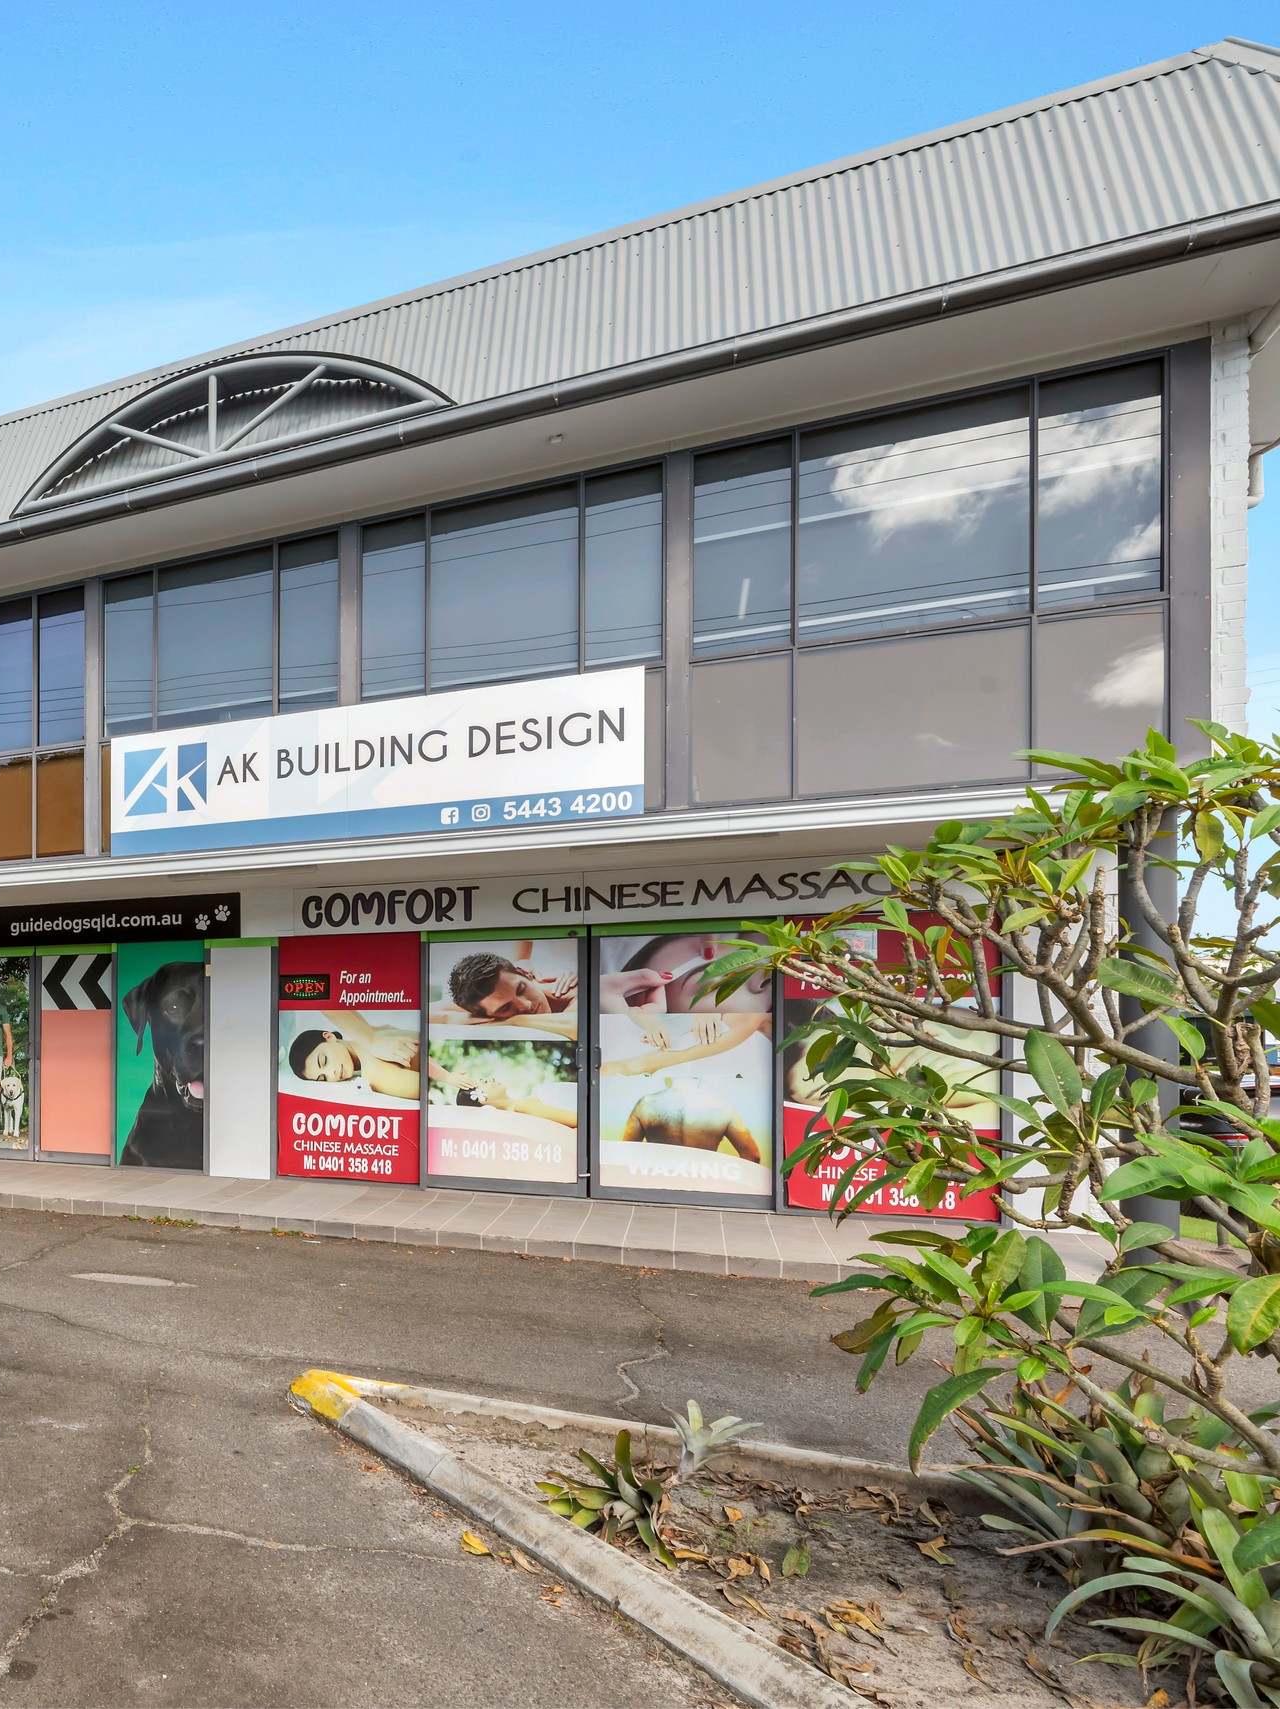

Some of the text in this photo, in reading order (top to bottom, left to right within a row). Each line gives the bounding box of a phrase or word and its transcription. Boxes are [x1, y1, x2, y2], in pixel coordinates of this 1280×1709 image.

[216, 707, 625, 786] AK BUILDING DESIGN
[503, 790, 633, 820] 5443 4200
[302, 870, 905, 929] COMFORT CHINESE MASSAG
[11, 913, 182, 936] guidedogsqld.com.au
[284, 982, 326, 993] OPEN
[340, 970, 372, 984] For an
[339, 989, 412, 1006] Appointment...
[292, 1112, 403, 1140] COMFORT
[293, 1140, 399, 1156] CHINESE MASSAGE
[441, 1139, 562, 1163] M: 0401 358 418
[303, 1155, 393, 1175] M: 0401 358 418
[627, 1159, 742, 1180] WAXING
